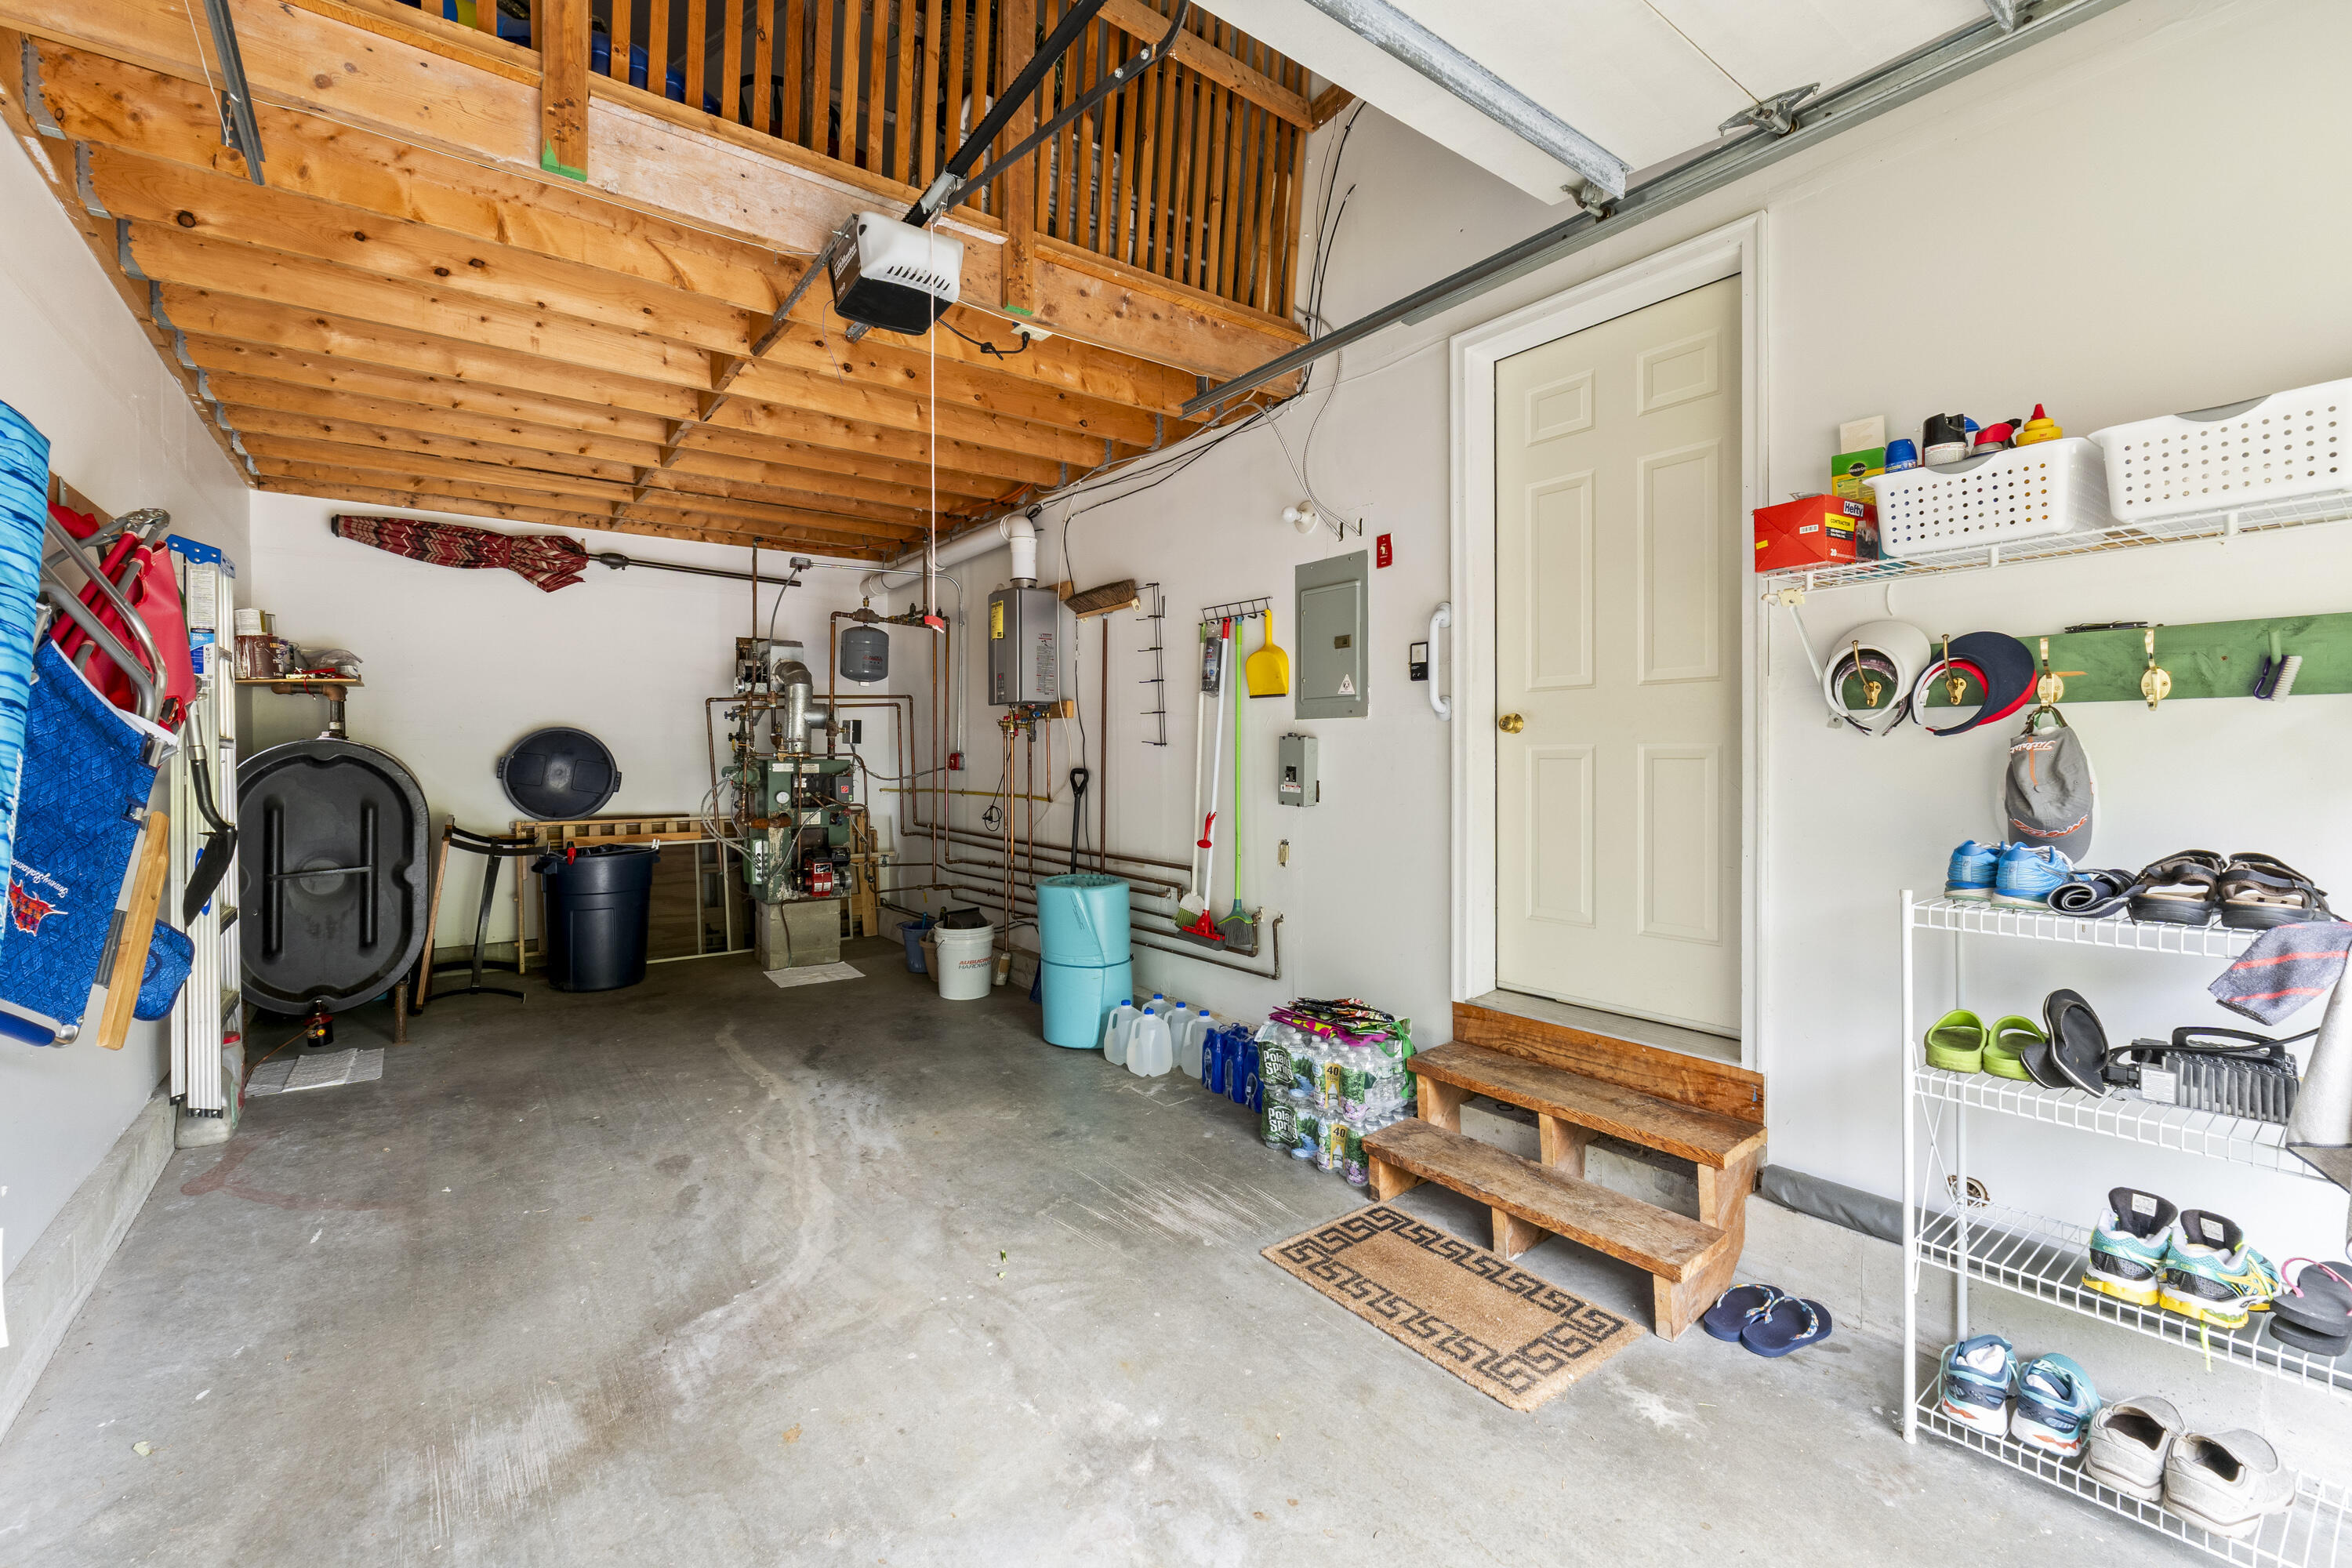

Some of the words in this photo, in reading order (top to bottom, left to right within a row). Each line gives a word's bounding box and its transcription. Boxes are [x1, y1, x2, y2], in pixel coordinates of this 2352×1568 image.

[1845, 503, 1864, 517] Hefty
[1830, 518, 1851, 527] CONTRACTOR
[41, 872, 69, 899] Tommy
[1263, 1050, 1292, 1069] Poland
[1265, 1062, 1294, 1080] Spring
[1327, 1065, 1339, 1076] 40
[1268, 1107, 1297, 1128] Poland
[1269, 1119, 1299, 1140] Spring
[1333, 1127, 1345, 1138] 40
